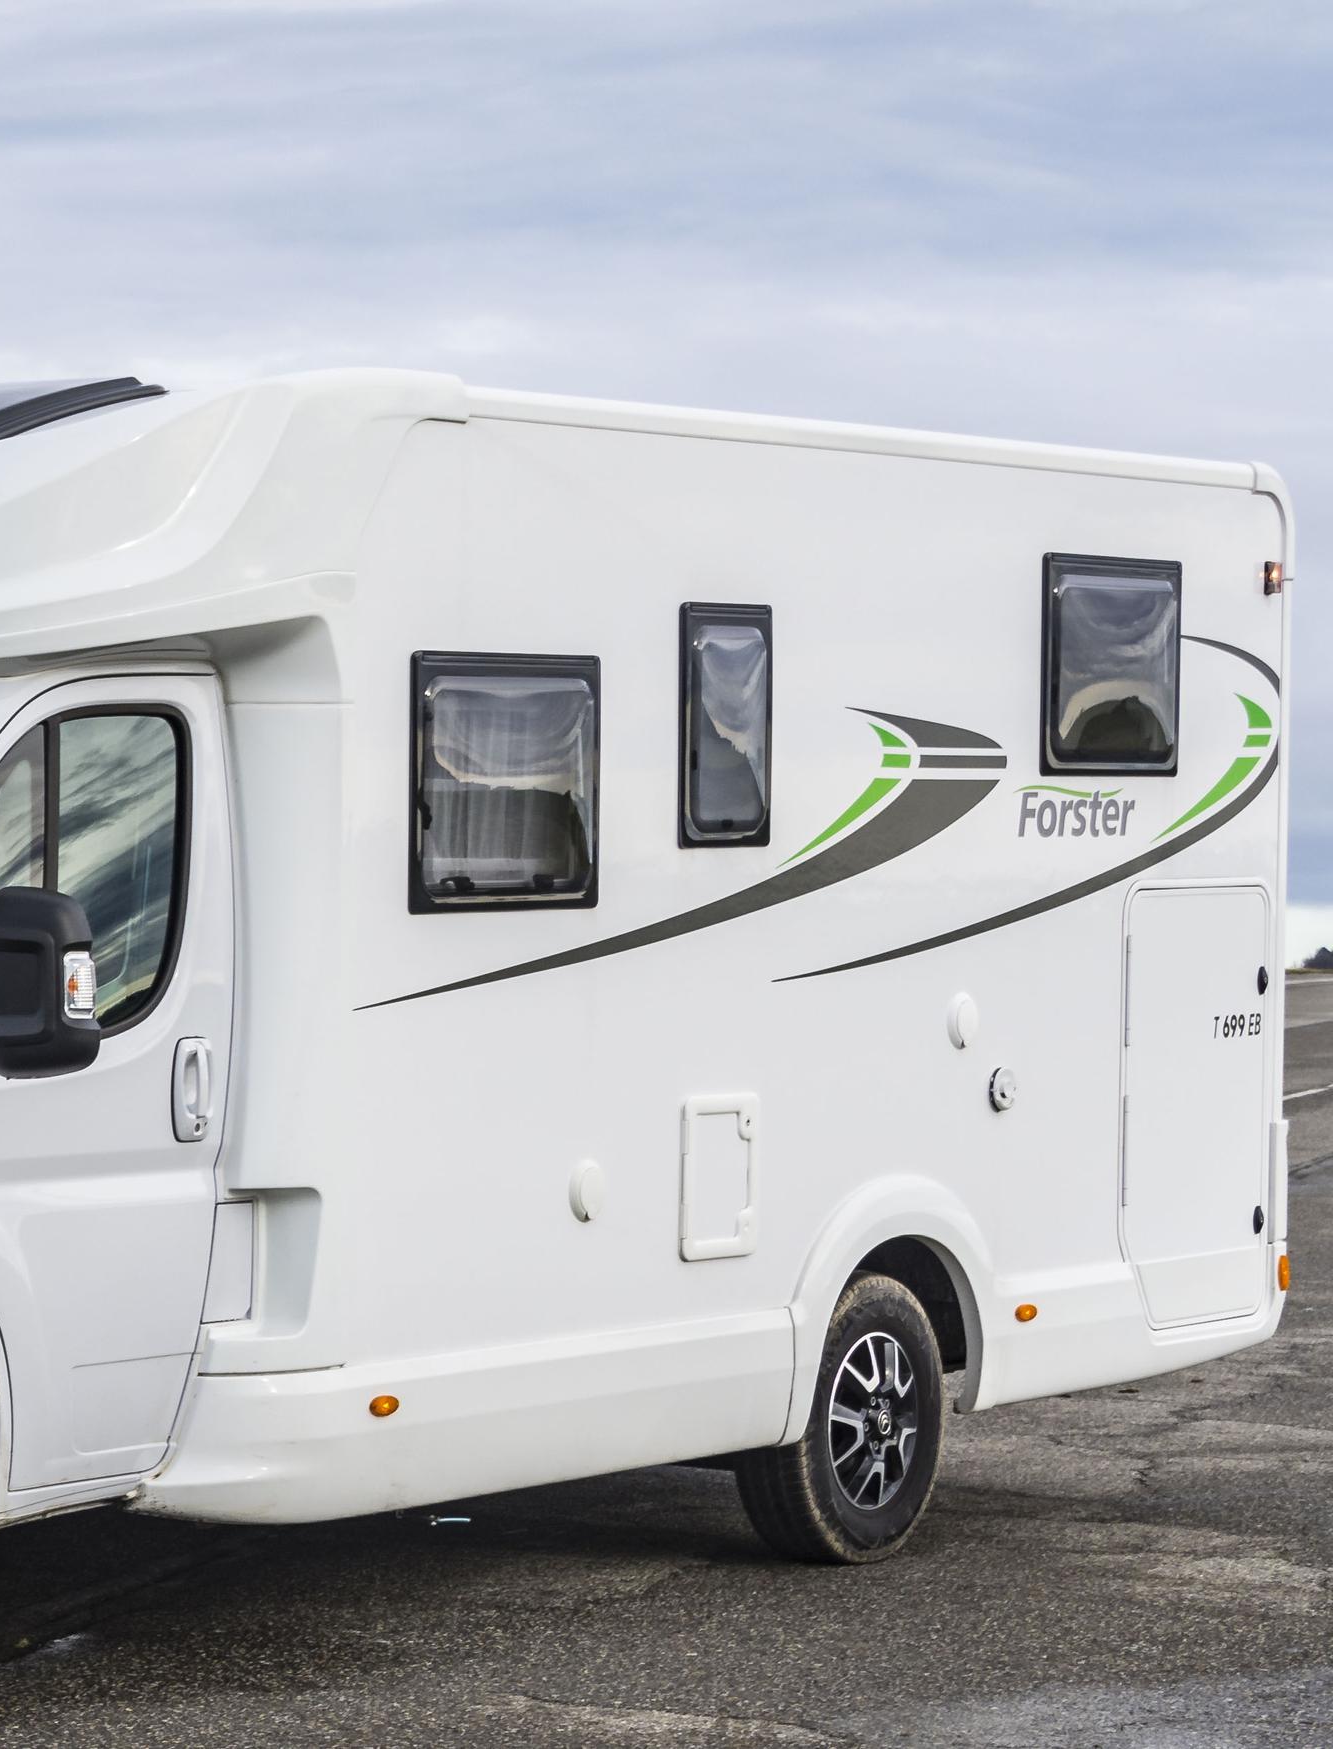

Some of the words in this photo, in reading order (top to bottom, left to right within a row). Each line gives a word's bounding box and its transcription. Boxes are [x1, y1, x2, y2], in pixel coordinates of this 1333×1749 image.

[1017, 789, 1136, 838] Forster
[1213, 1016, 1220, 1039] T
[1222, 1014, 1246, 1039] 699
[1248, 1013, 1262, 1036] EB
